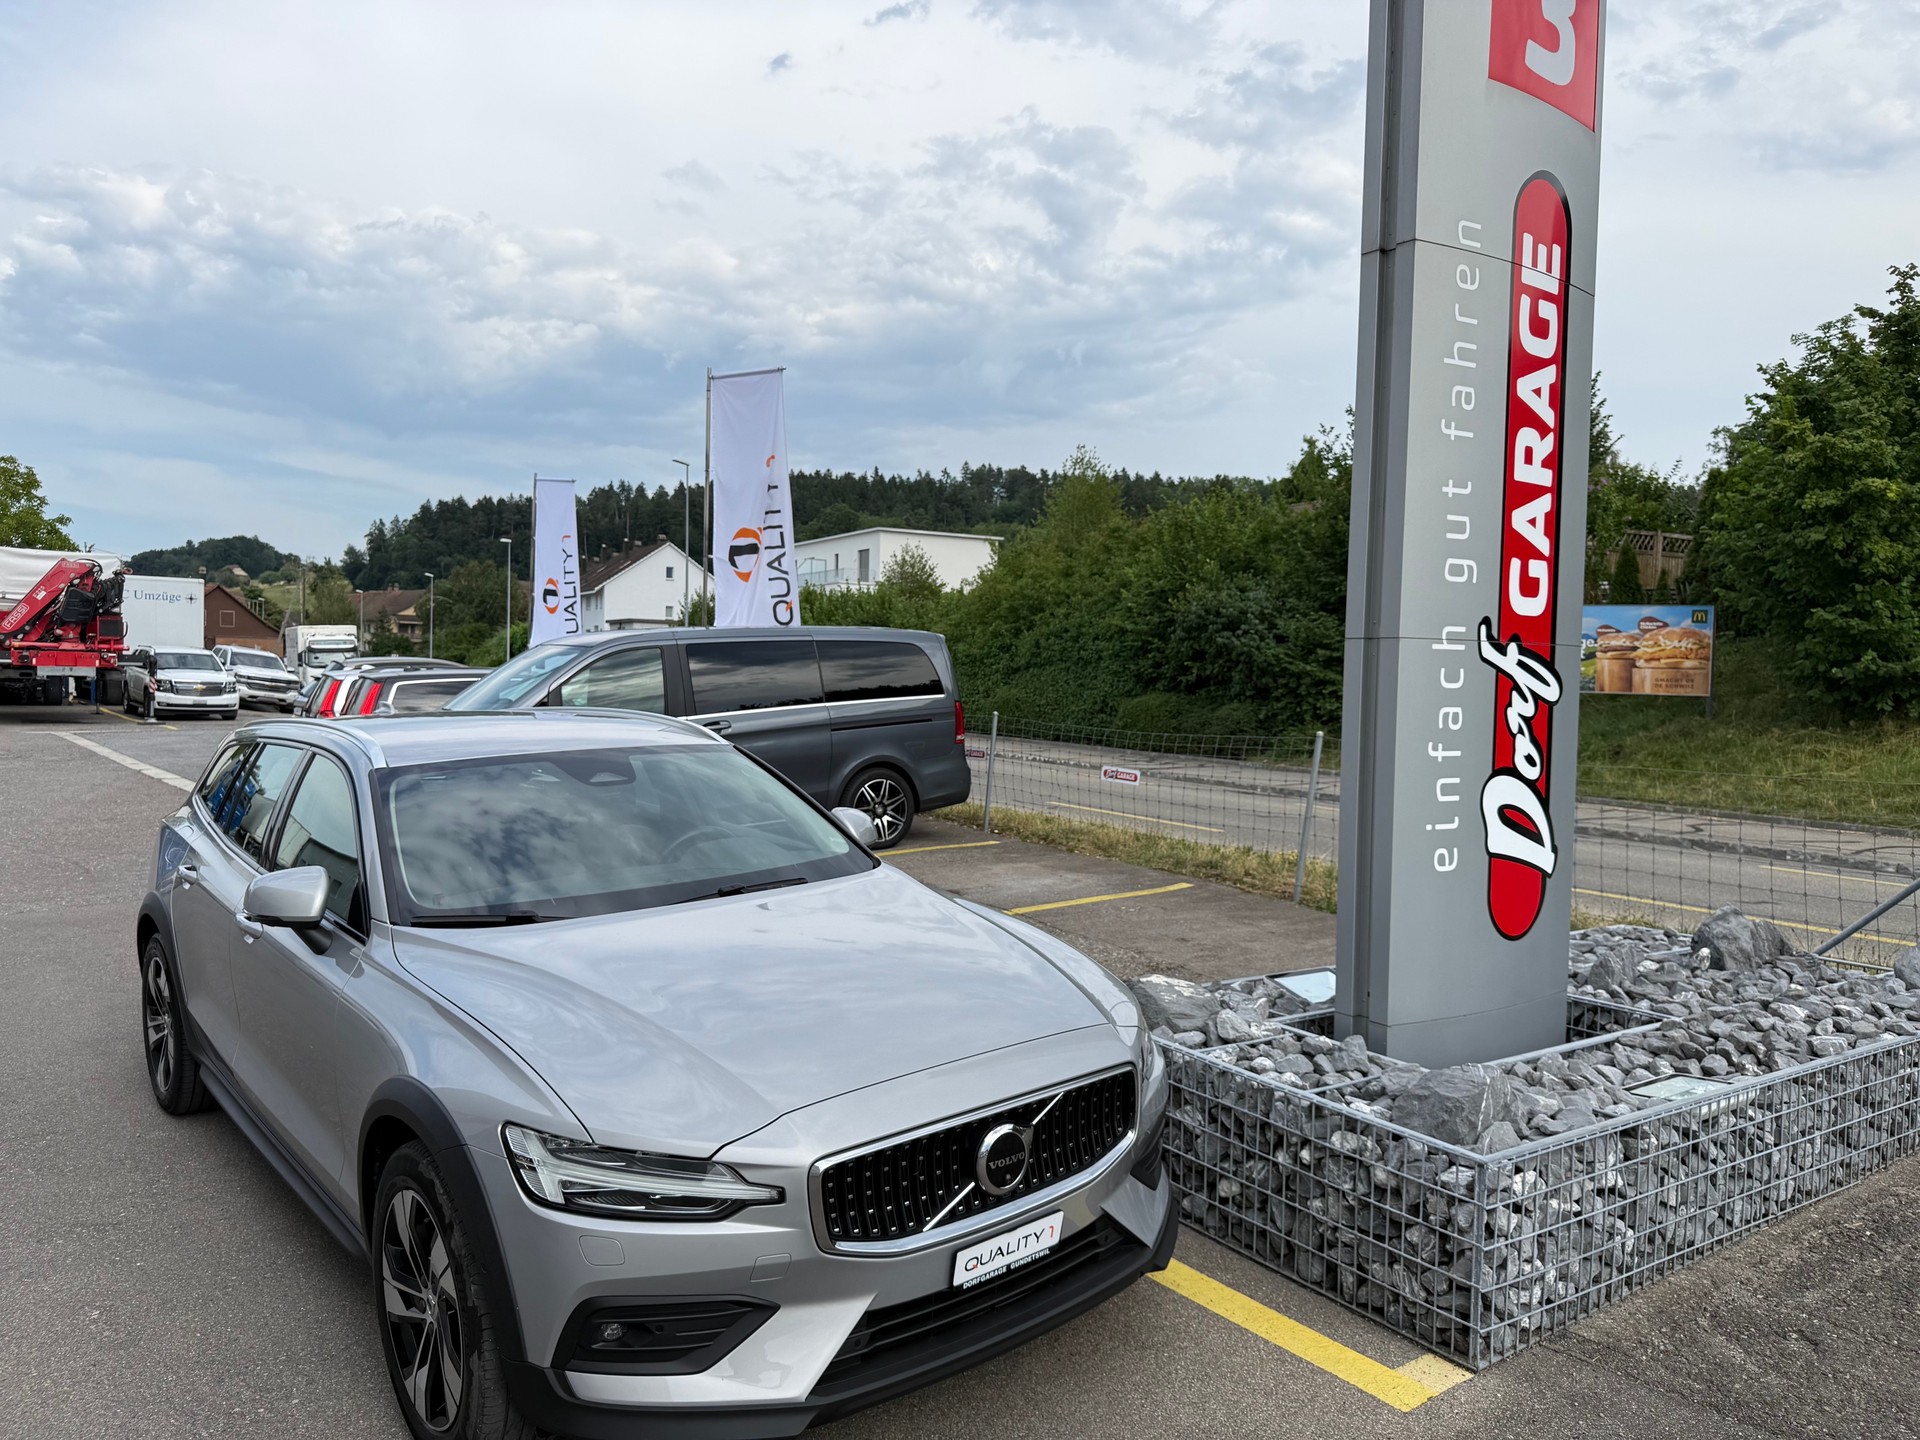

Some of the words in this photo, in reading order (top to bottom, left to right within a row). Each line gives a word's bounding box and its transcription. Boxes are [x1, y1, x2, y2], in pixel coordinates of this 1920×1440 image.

[1441, 219, 1482, 442] fahren
[1508, 232, 1562, 617] GARAGE
[1441, 479, 1477, 585] gut
[134, 590, 182, 604] Umzüge
[1426, 626, 1467, 873] einfach
[1479, 617, 1562, 878] Dorf
[987, 1151, 1026, 1170] VOLVO
[962, 1265, 1007, 1290] DORFGARAGE
[1010, 1248, 1051, 1270] GUNDETSWIL
[964, 1228, 1046, 1272] QUALITY
